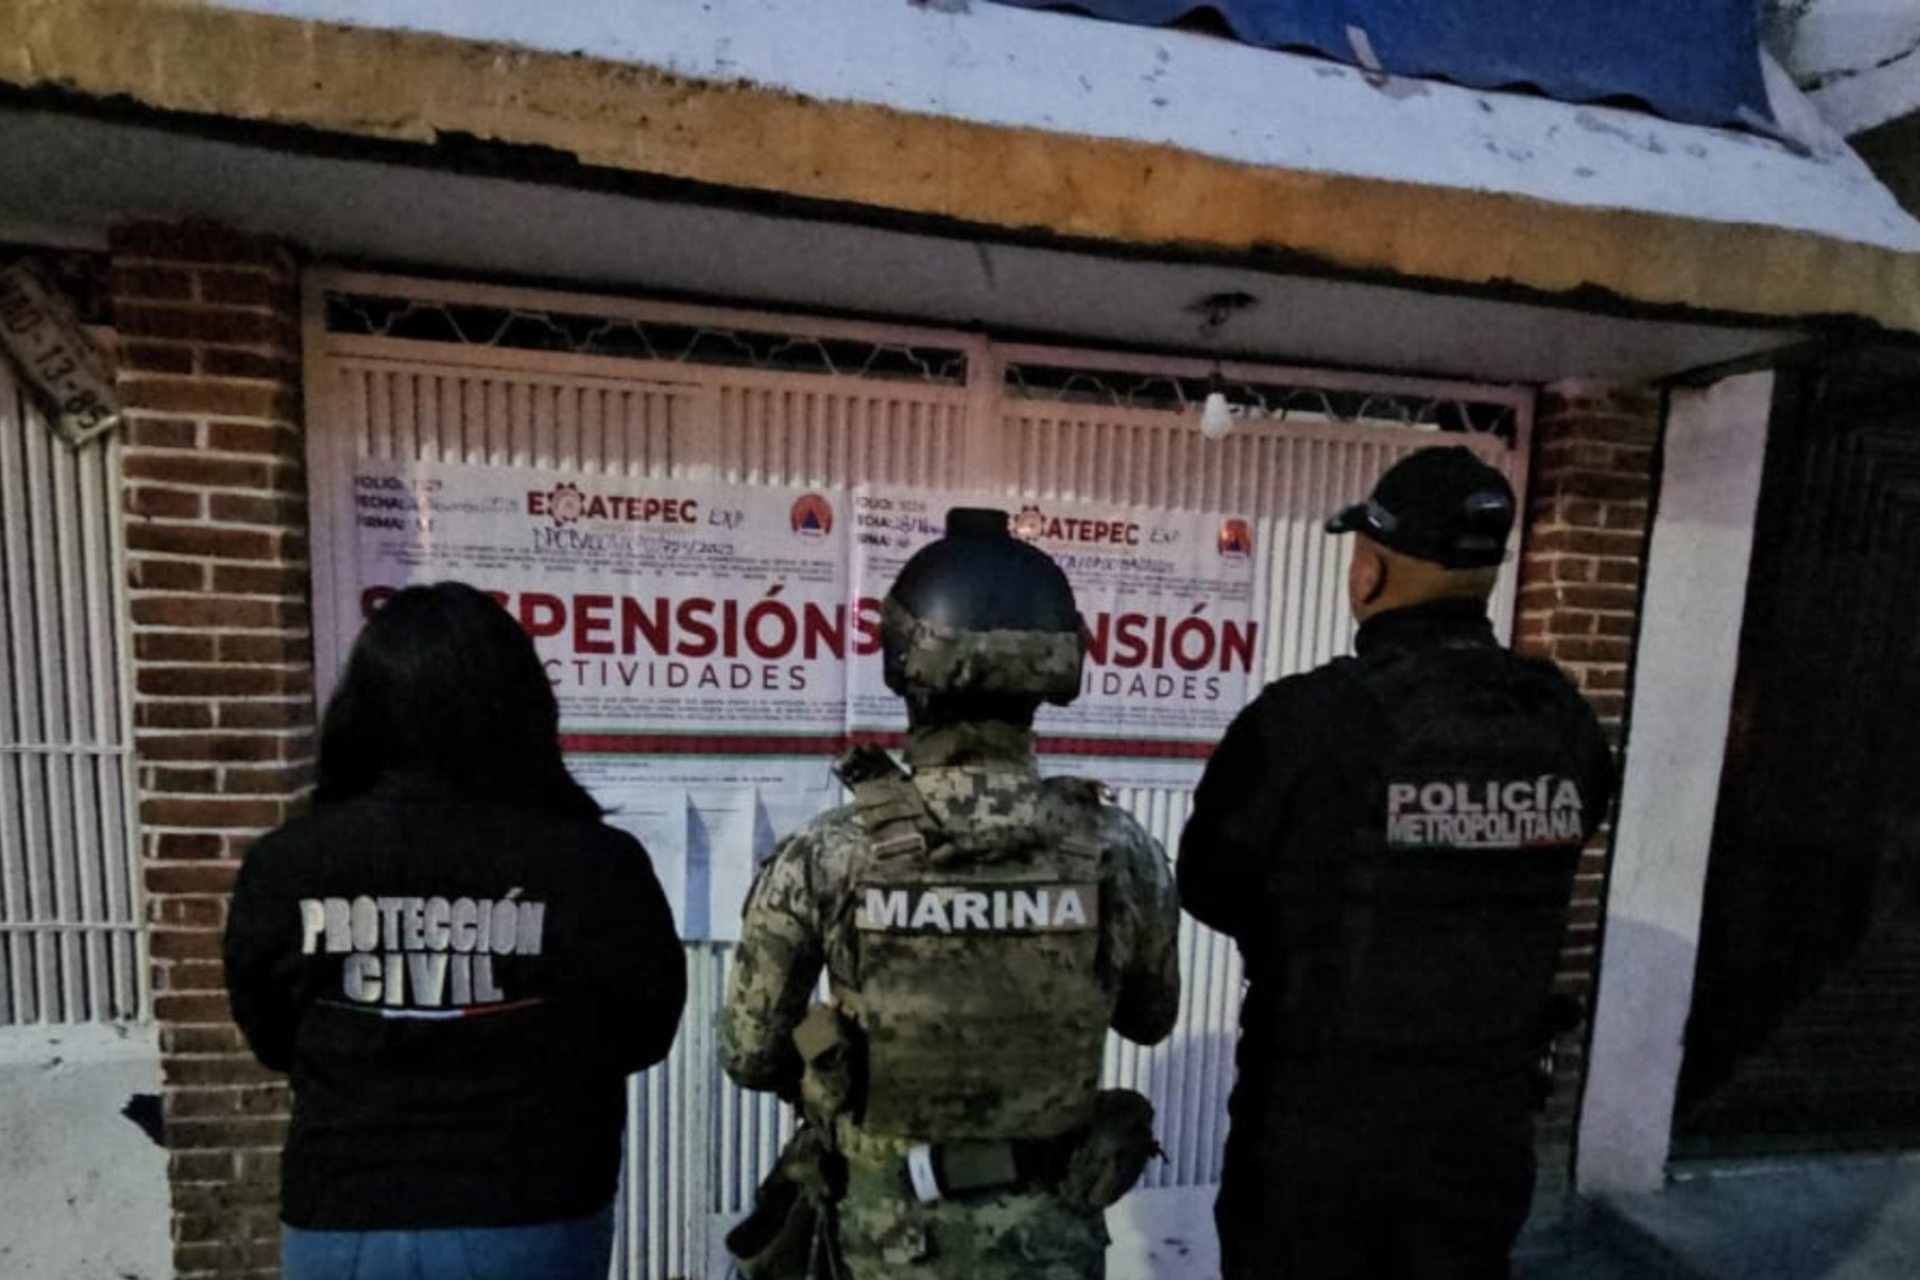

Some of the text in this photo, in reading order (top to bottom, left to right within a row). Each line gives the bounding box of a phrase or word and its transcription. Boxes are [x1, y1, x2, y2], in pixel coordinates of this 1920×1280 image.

[527, 483, 698, 526] EATEPEC
[361, 584, 845, 660] PENSIÓN
[853, 597, 1258, 674] SNSIÓN
[544, 658, 807, 691] CTIVIDADES
[1086, 671, 1221, 701] IDADES
[1387, 774, 1584, 814] POLICÍA
[1387, 810, 1583, 843] METROPOLITANA
[299, 887, 546, 955] PROTECCIÓN
[864, 887, 1088, 930] MARINA
[343, 952, 505, 1006] CIVIL
